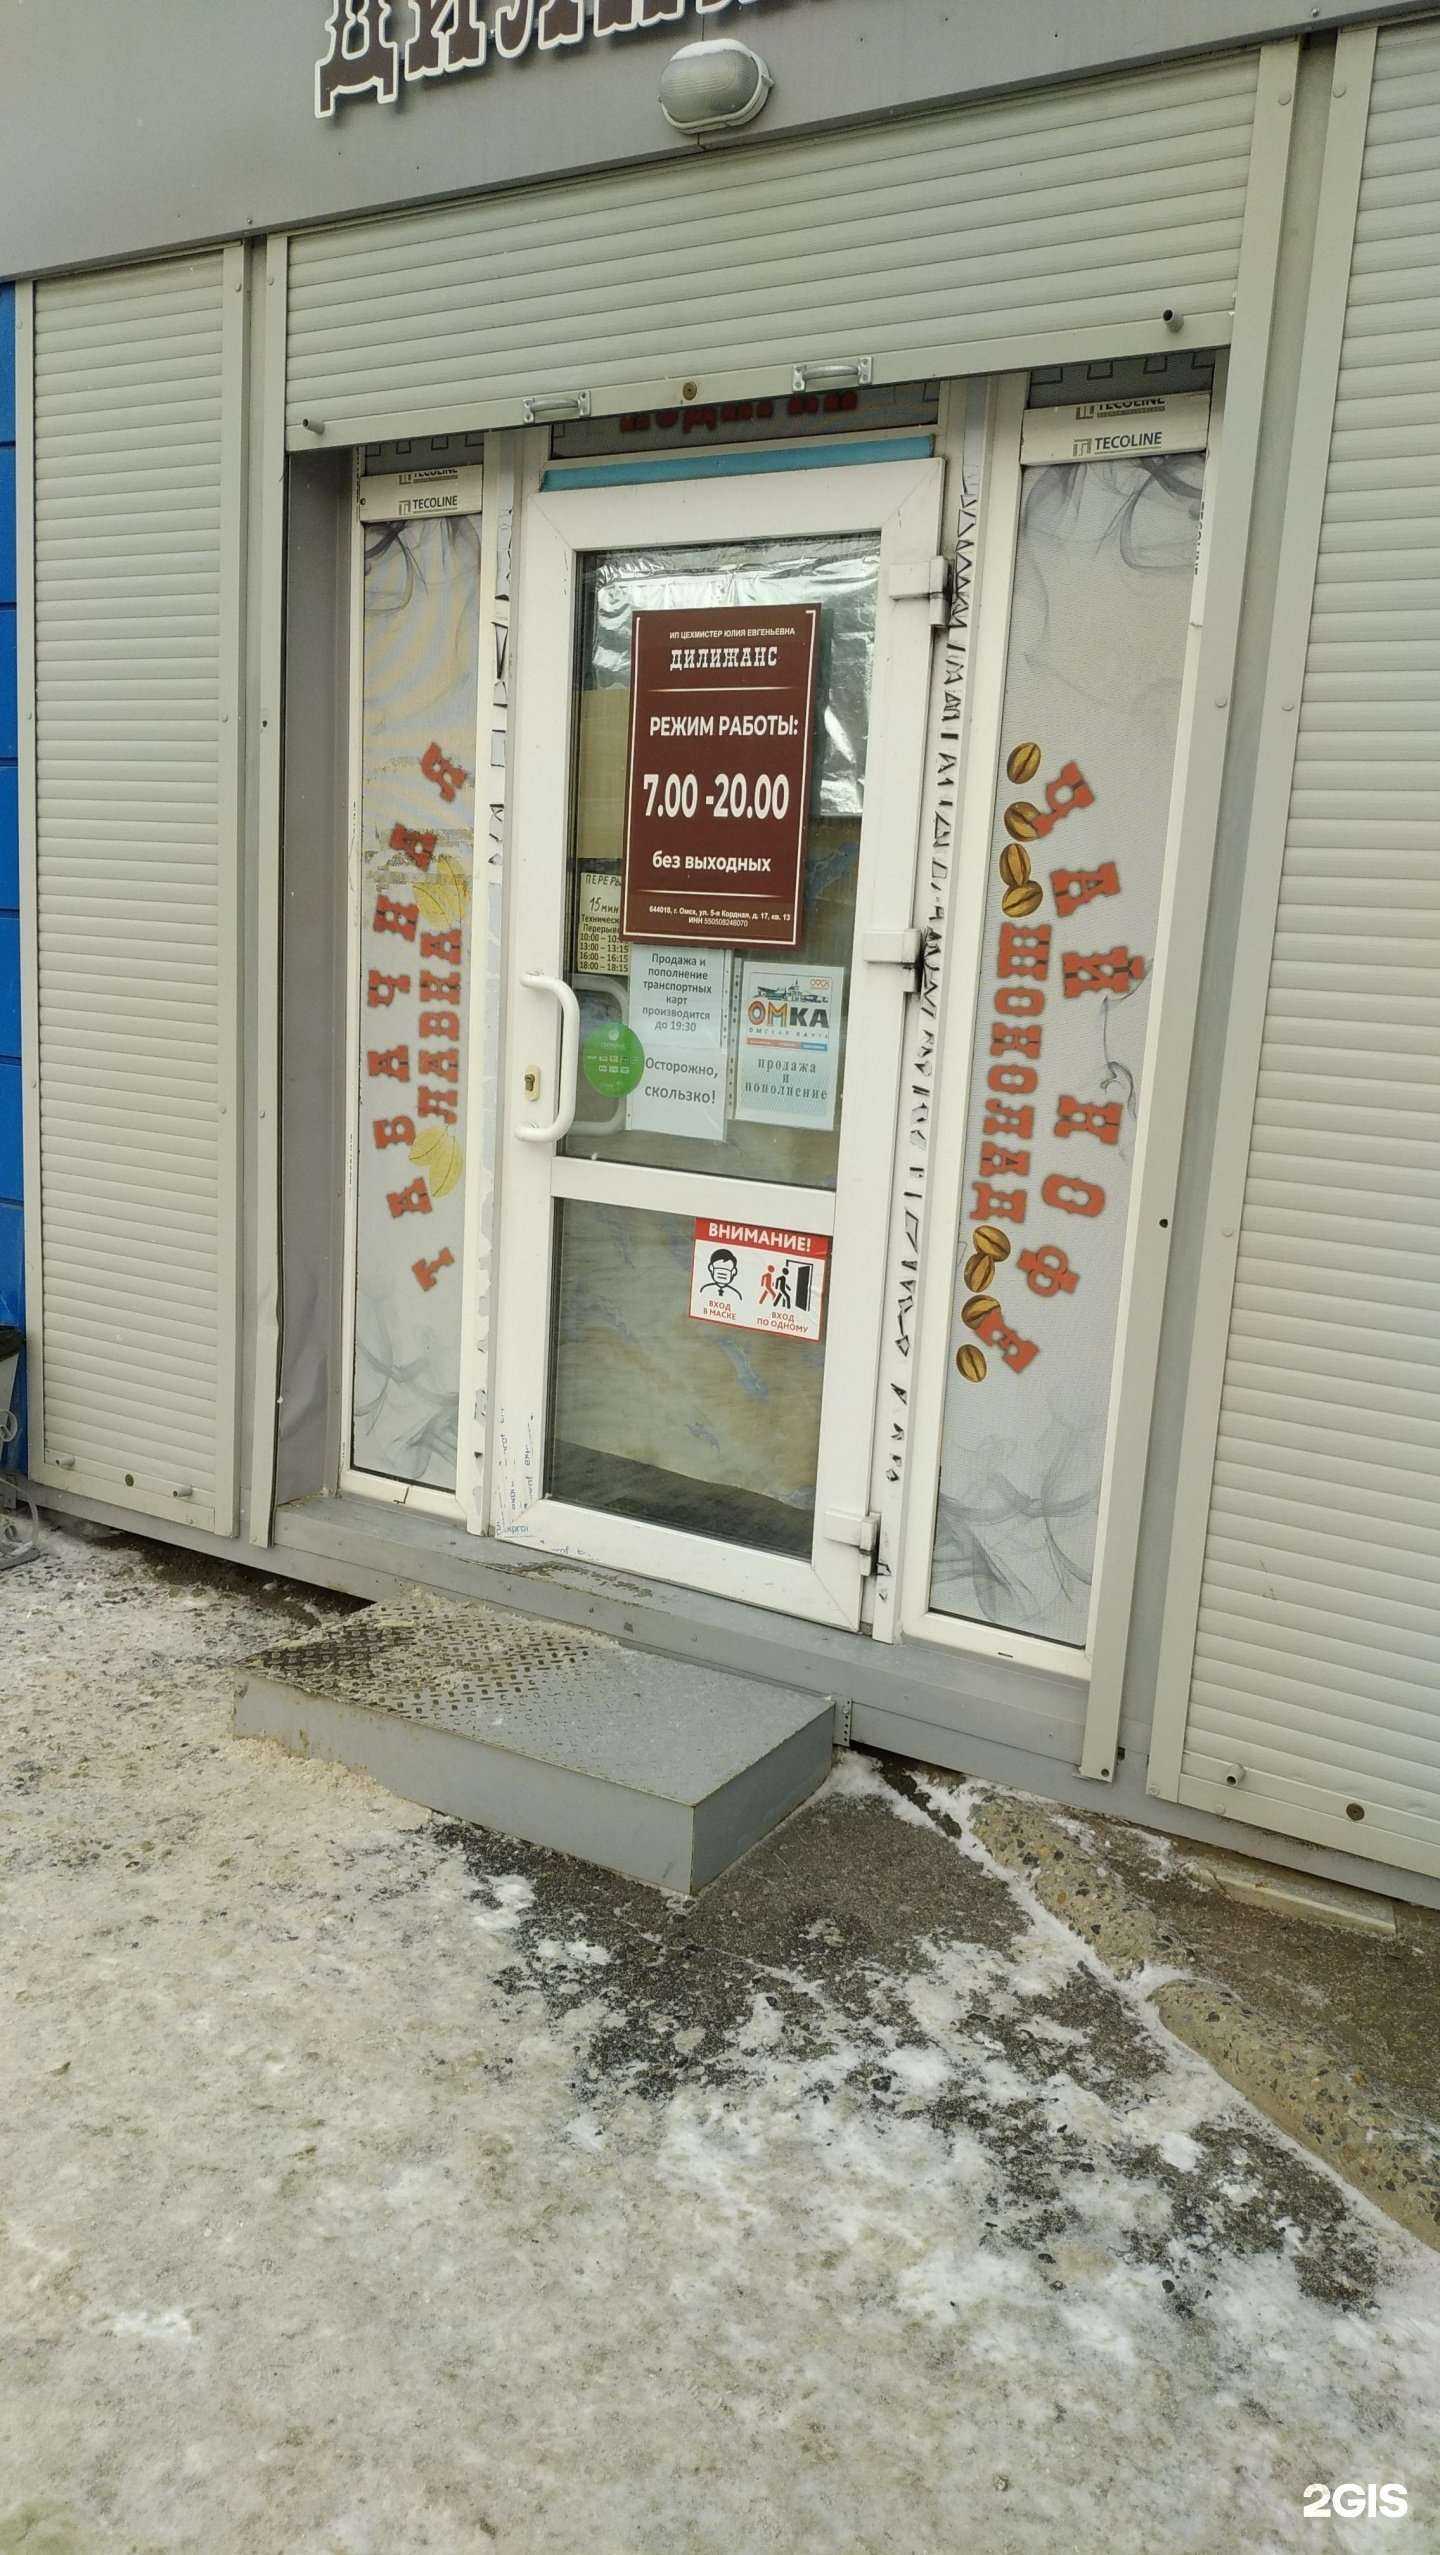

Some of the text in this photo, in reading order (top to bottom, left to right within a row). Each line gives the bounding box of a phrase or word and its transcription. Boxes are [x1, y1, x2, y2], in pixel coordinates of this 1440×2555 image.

[1094, 431, 1163, 451] TECOLINE
[412, 495, 458, 510] TECOLINE
[669, 627, 796, 640] ИП ЦЕХМИСТЕР ЮЛИЯ ЕВГЕНЬЕВНА
[669, 646, 778, 671] ДИЛИЖАНС
[649, 714, 799, 737] РЕЖИМ РАБОТЫ:
[643, 772, 699, 819] 7.00
[652, 850, 772, 874] без выходных
[1030, 760, 1147, 1000] ЧАЙ
[589, 896, 601, 912] 15
[688, 916, 703, 925] ИНН
[782, 913, 791, 922] 13
[652, 953, 706, 967] Продажа и
[648, 968, 708, 980] пополнение
[643, 981, 712, 994] транспортных
[666, 996, 688, 1006] карт
[367, 742, 468, 1292] ТАБАЧНАЯ
[642, 1007, 711, 1020] производится
[747, 1000, 830, 1029] ОМКА
[416, 928, 462, 1126] ЛАВКА
[654, 1020, 697, 1032] до 19:30
[645, 1057, 718, 1079] Осторожно,
[758, 1058, 816, 1074] продажа
[969, 921, 1054, 1225] ШОКОЛАД
[645, 1086, 716, 1104] скользко!
[745, 1081, 829, 1100] пополнение
[708, 1222, 812, 1253] ВНИМАНИЕ!
[973, 1094, 1125, 1376] КОФЕ
[708, 1300, 732, 1312] ВХОД
[709, 1307, 737, 1321] МАСКЕ
[757, 1317, 809, 1334] ПО ОДНОМУ
[771, 1311, 795, 1323] ВХОД
